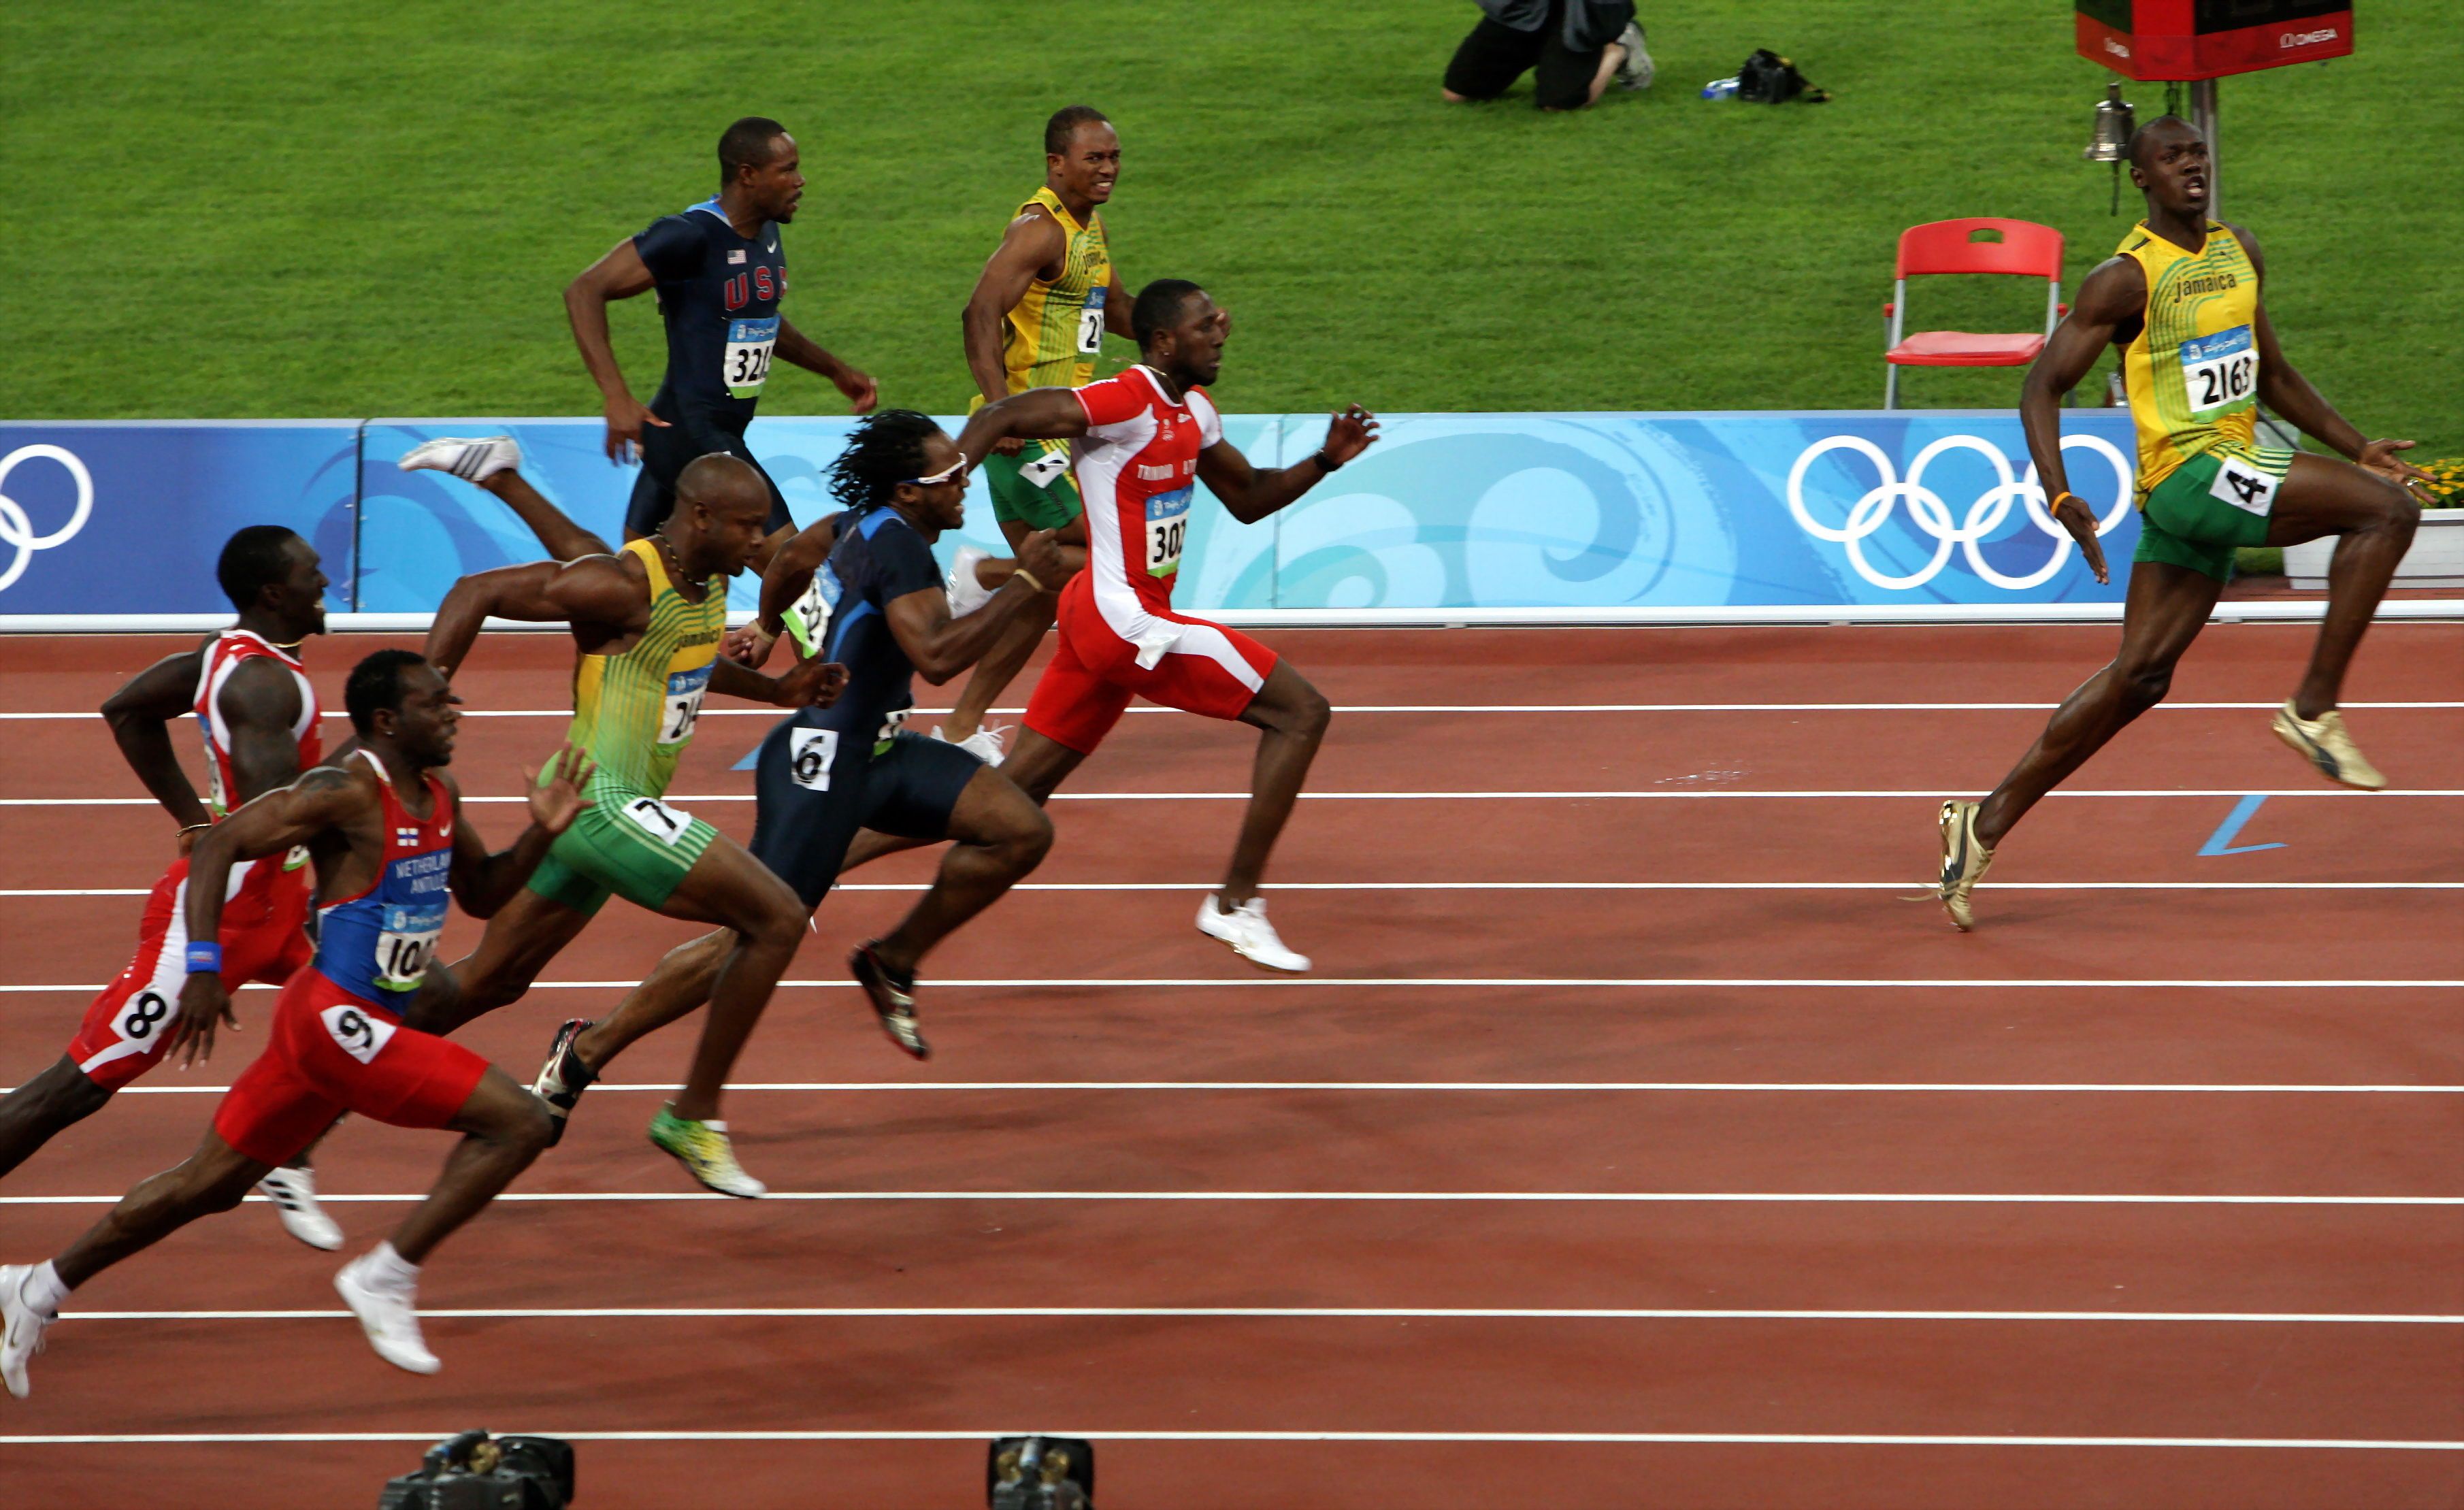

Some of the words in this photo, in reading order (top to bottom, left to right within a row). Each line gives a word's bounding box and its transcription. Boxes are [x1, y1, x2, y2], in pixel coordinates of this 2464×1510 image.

[2227, 470, 2267, 504] 4
[796, 736, 825, 783] 6
[634, 800, 677, 830] 7
[125, 993, 166, 1038] 8
[339, 1011, 373, 1049] 9
